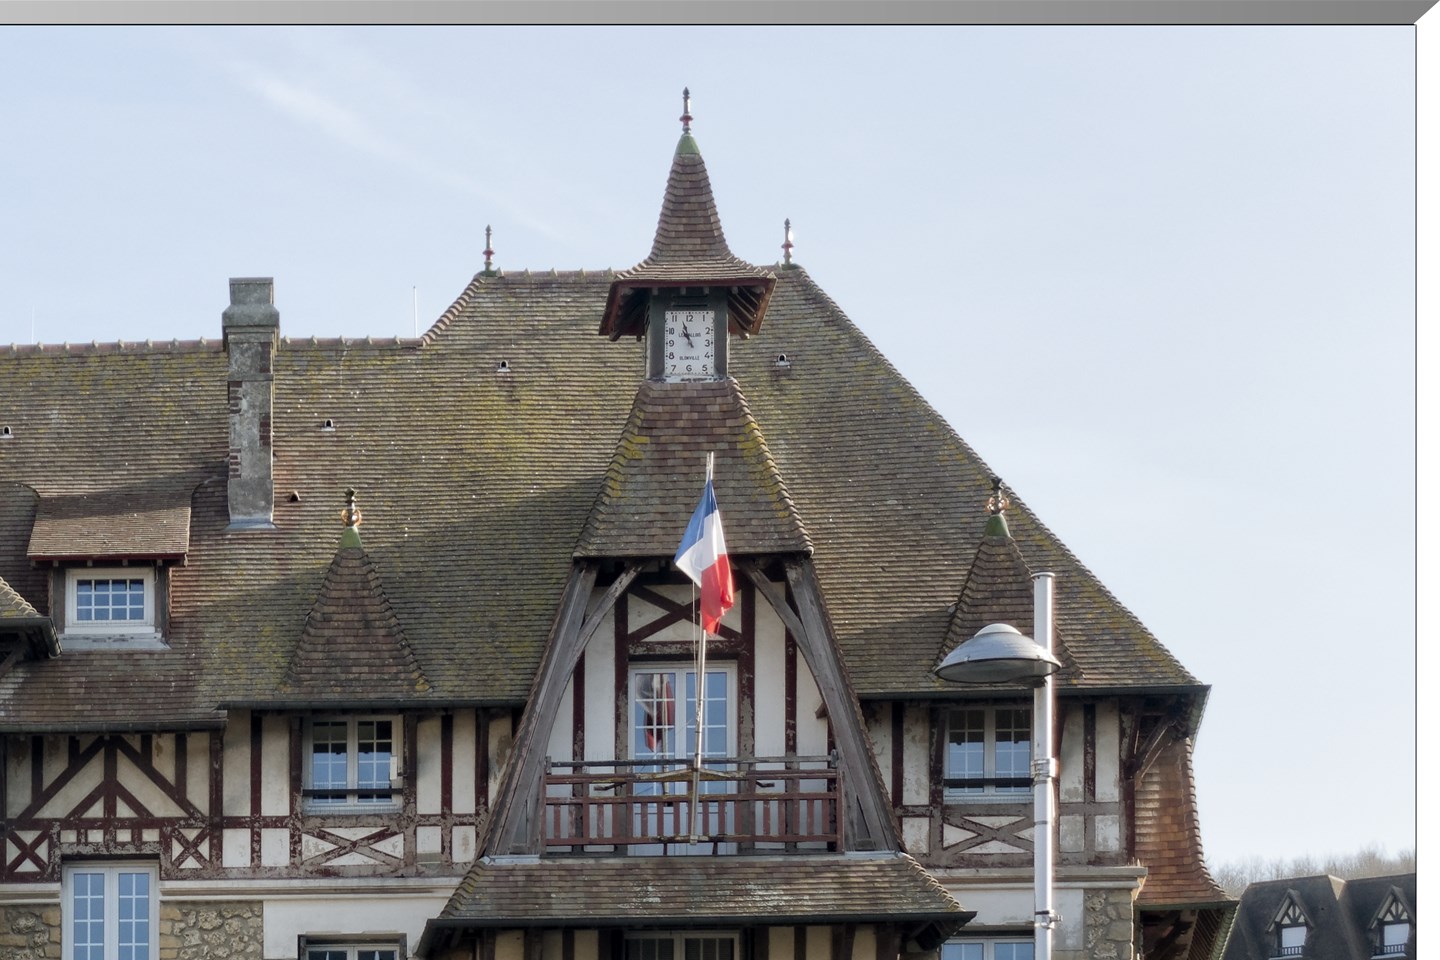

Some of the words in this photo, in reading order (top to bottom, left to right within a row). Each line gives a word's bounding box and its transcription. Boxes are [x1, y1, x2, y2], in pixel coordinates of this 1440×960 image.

[668, 327, 675, 335] 10
[705, 327, 711, 335] 2
[669, 352, 675, 360] 8
